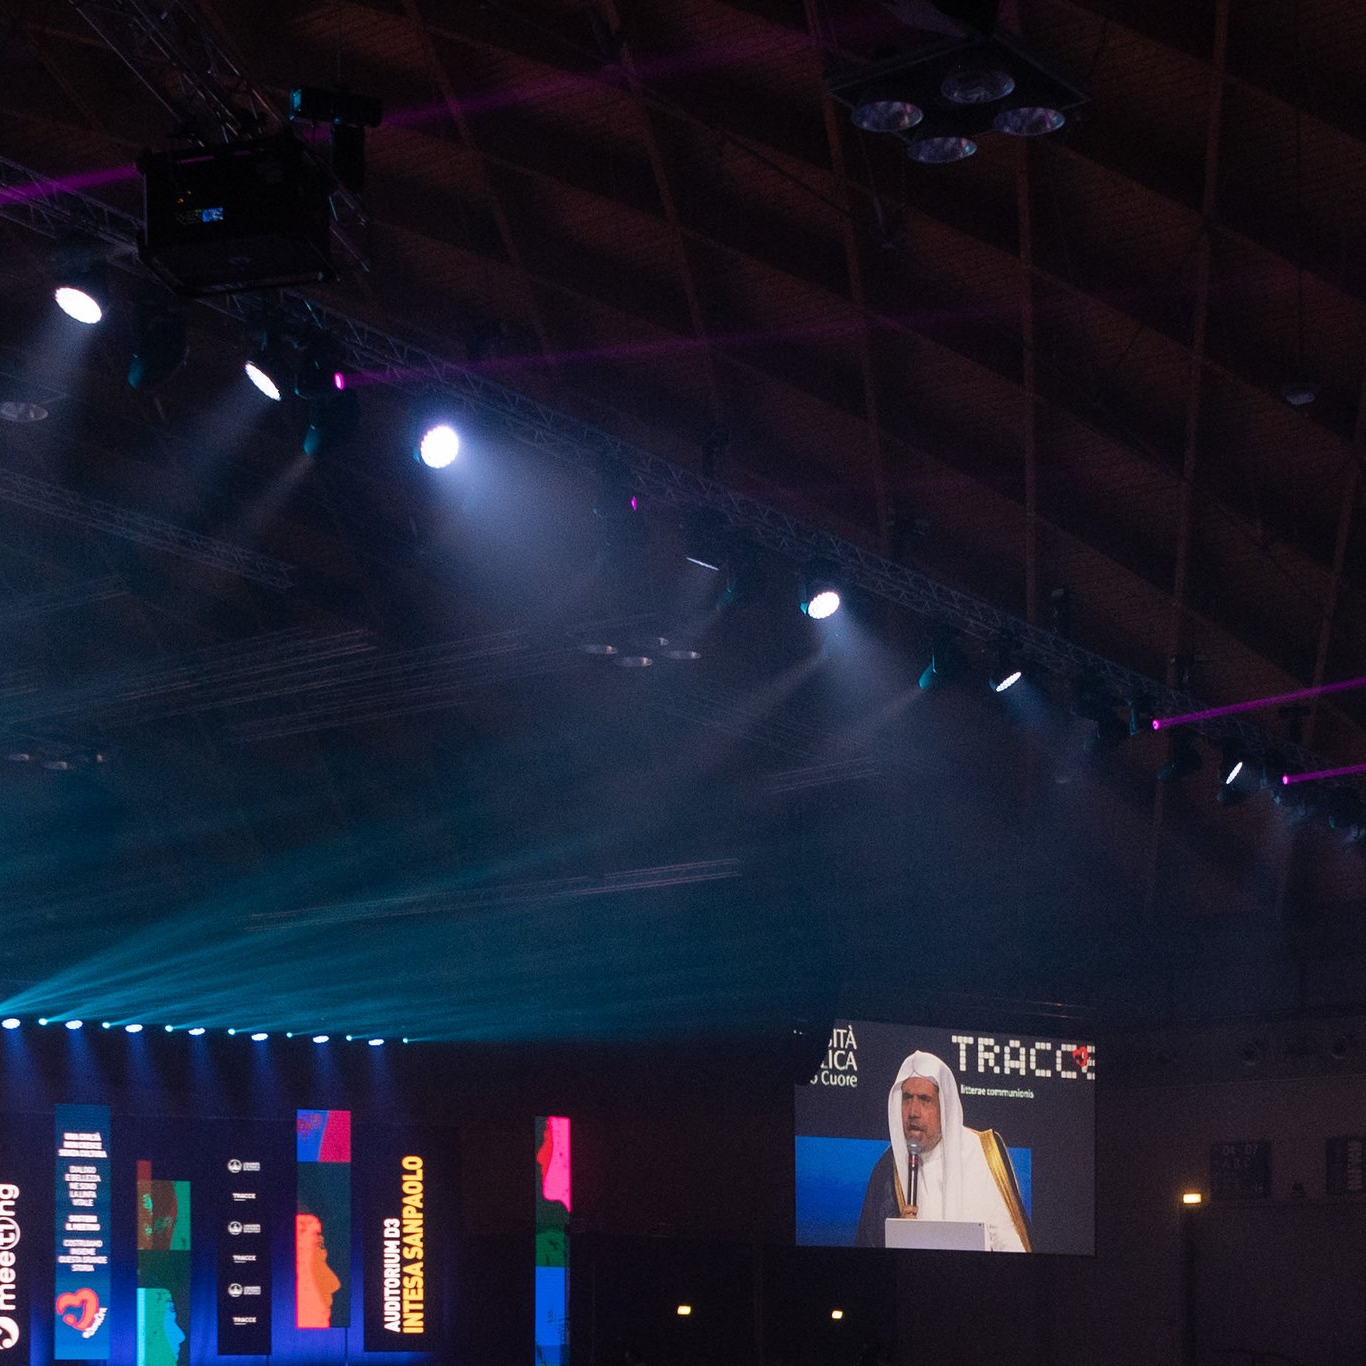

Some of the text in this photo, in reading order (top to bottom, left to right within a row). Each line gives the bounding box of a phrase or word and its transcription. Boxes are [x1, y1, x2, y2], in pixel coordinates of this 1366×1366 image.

[821, 1070, 858, 1088] Cuore
[384, 1218, 401, 1332] AUDITORIUM D3
[402, 1155, 424, 1334] INTESA SANPAOLO
